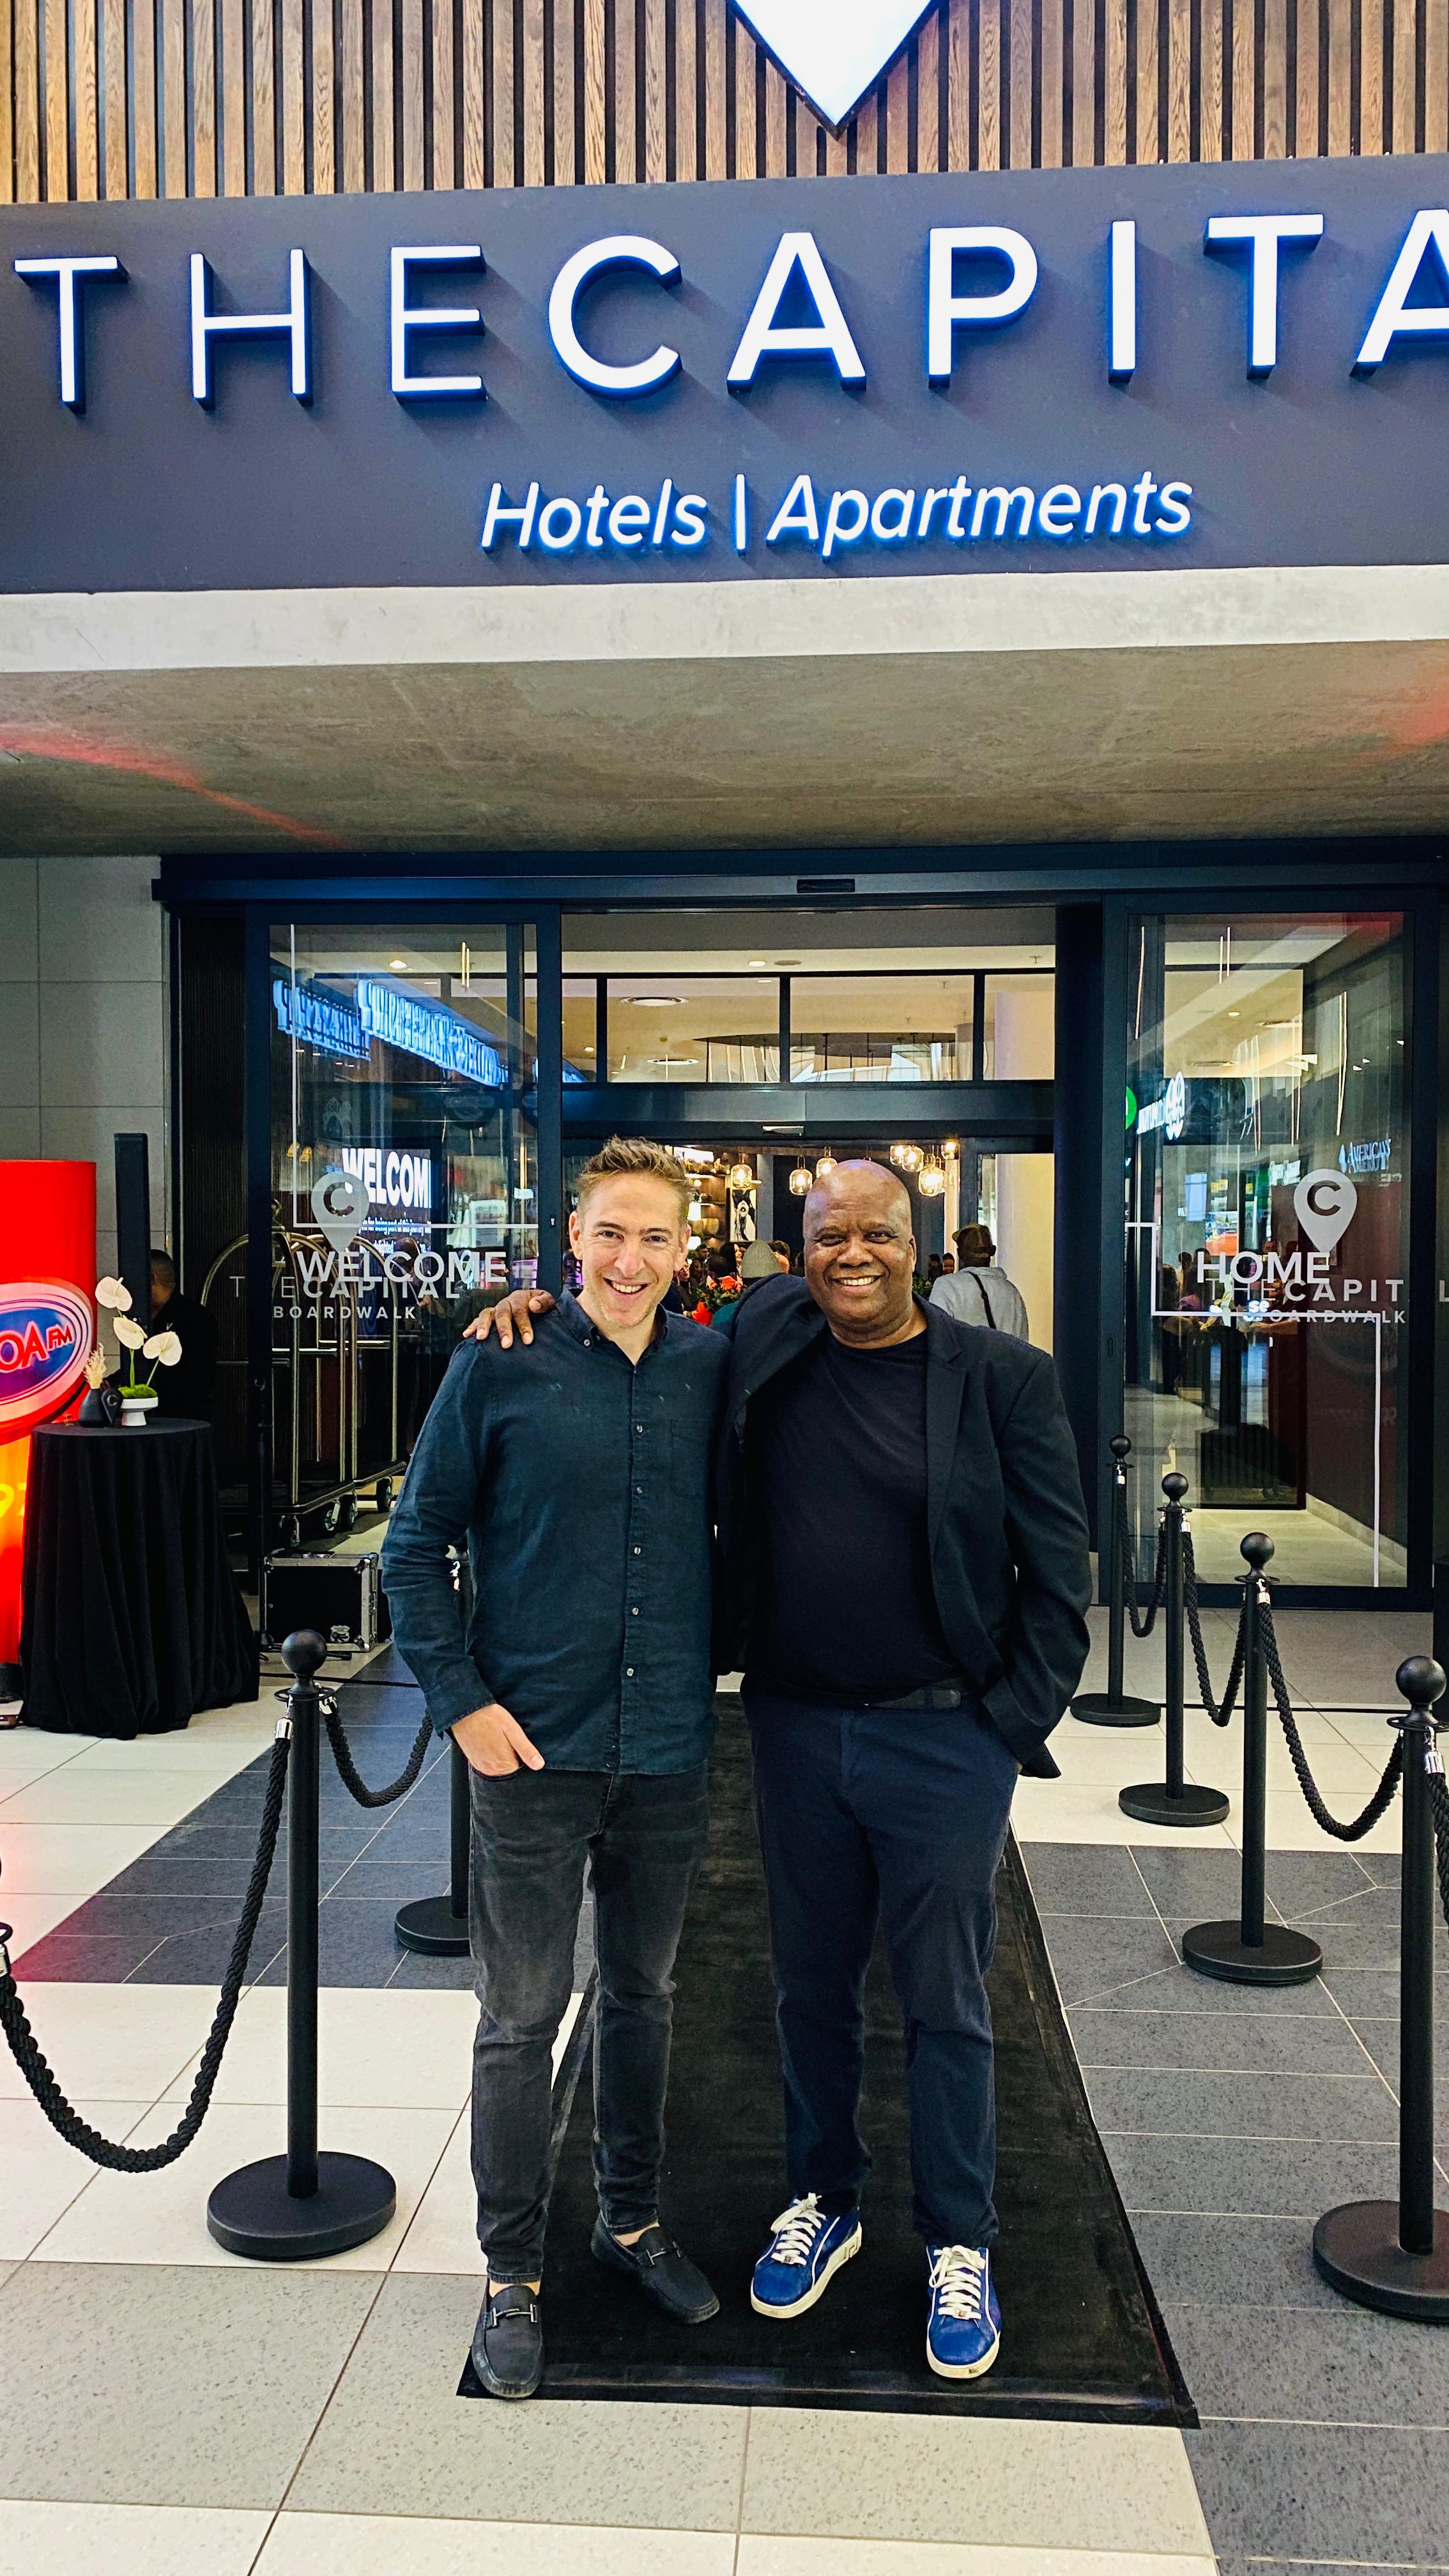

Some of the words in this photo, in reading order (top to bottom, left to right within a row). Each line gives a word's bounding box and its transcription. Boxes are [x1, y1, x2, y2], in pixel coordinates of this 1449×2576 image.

[481, 479, 709, 551] Hotels
[766, 471, 1195, 560] Apartments
[342, 1148, 431, 1208] WELCOM
[297, 1250, 507, 1283] WELCOME
[1197, 1251, 1330, 1284] HOME
[229, 1276, 296, 1298] TE
[303, 1277, 460, 1299] CAPITAL
[1206, 1278, 1276, 1301] THE
[1284, 1278, 1449, 1302] CAPITL
[273, 1306, 417, 1319] BOARDWALK
[1255, 1309, 1406, 1324] OARDWALK
[47, 1322, 74, 1350] FM
